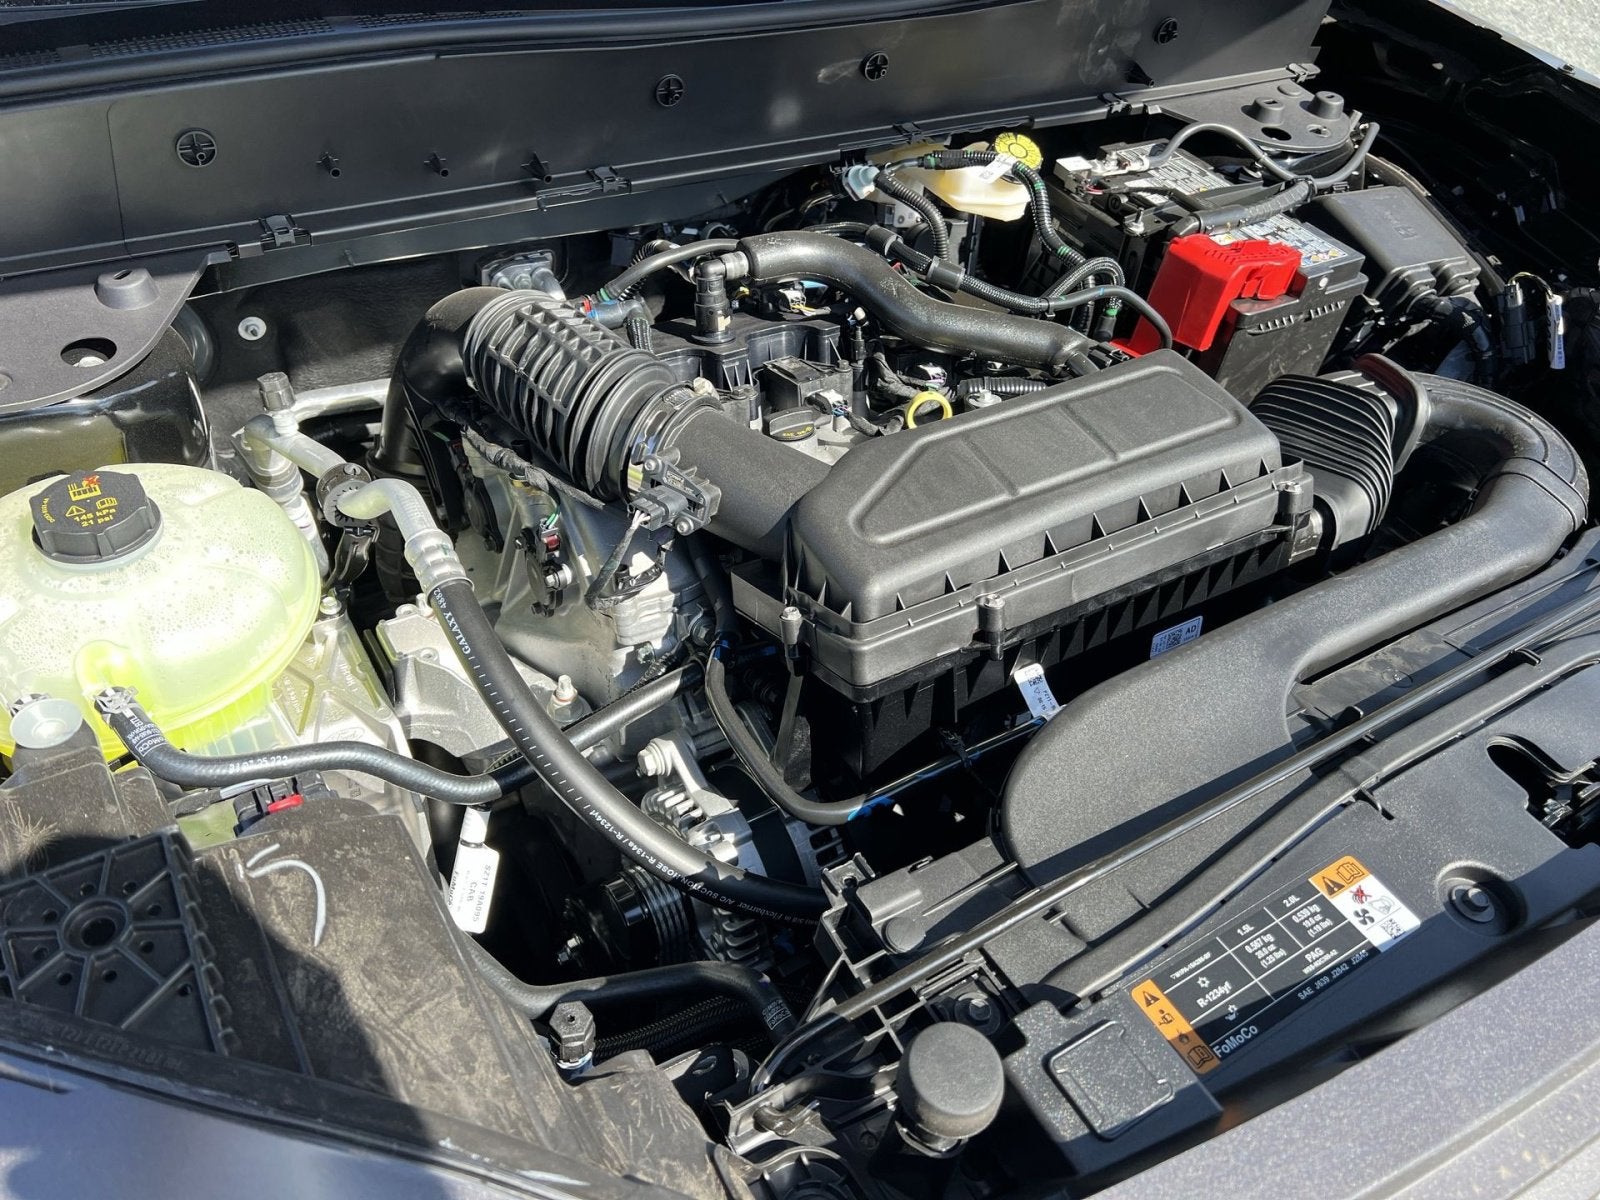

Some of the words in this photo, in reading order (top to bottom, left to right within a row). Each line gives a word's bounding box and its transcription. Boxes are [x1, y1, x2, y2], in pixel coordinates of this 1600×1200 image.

[74, 513, 94, 521] 145
[81, 519, 94, 527] 21
[97, 514, 113, 524] psi
[433, 587, 447, 609] 4882
[443, 611, 472, 655] GALAXY
[1185, 625, 1197, 635] AD
[589, 809, 624, 840] R-1234yf
[628, 841, 657, 865] R-134a
[656, 861, 682, 880] HOSE
[681, 877, 719, 900] SUCTION
[720, 896, 735, 906] A/C
[1283, 894, 1300, 907] 2.0L
[1307, 904, 1321, 913] kg
[738, 901, 783, 920] Flexbarrier
[1237, 923, 1255, 936] 1.5L
[1244, 937, 1263, 953] 0.567
[1261, 934, 1275, 943] kg
[1267, 943, 1277, 952] oz
[1260, 954, 1276, 969] (1.25
[1305, 947, 1325, 963] PAG
[1297, 986, 1314, 1000] SAE
[1314, 975, 1330, 989] J639
[1330, 963, 1350, 979] J2842
[1196, 981, 1232, 1008] R-1234yf
[1213, 1025, 1259, 1058] FoMoCo
